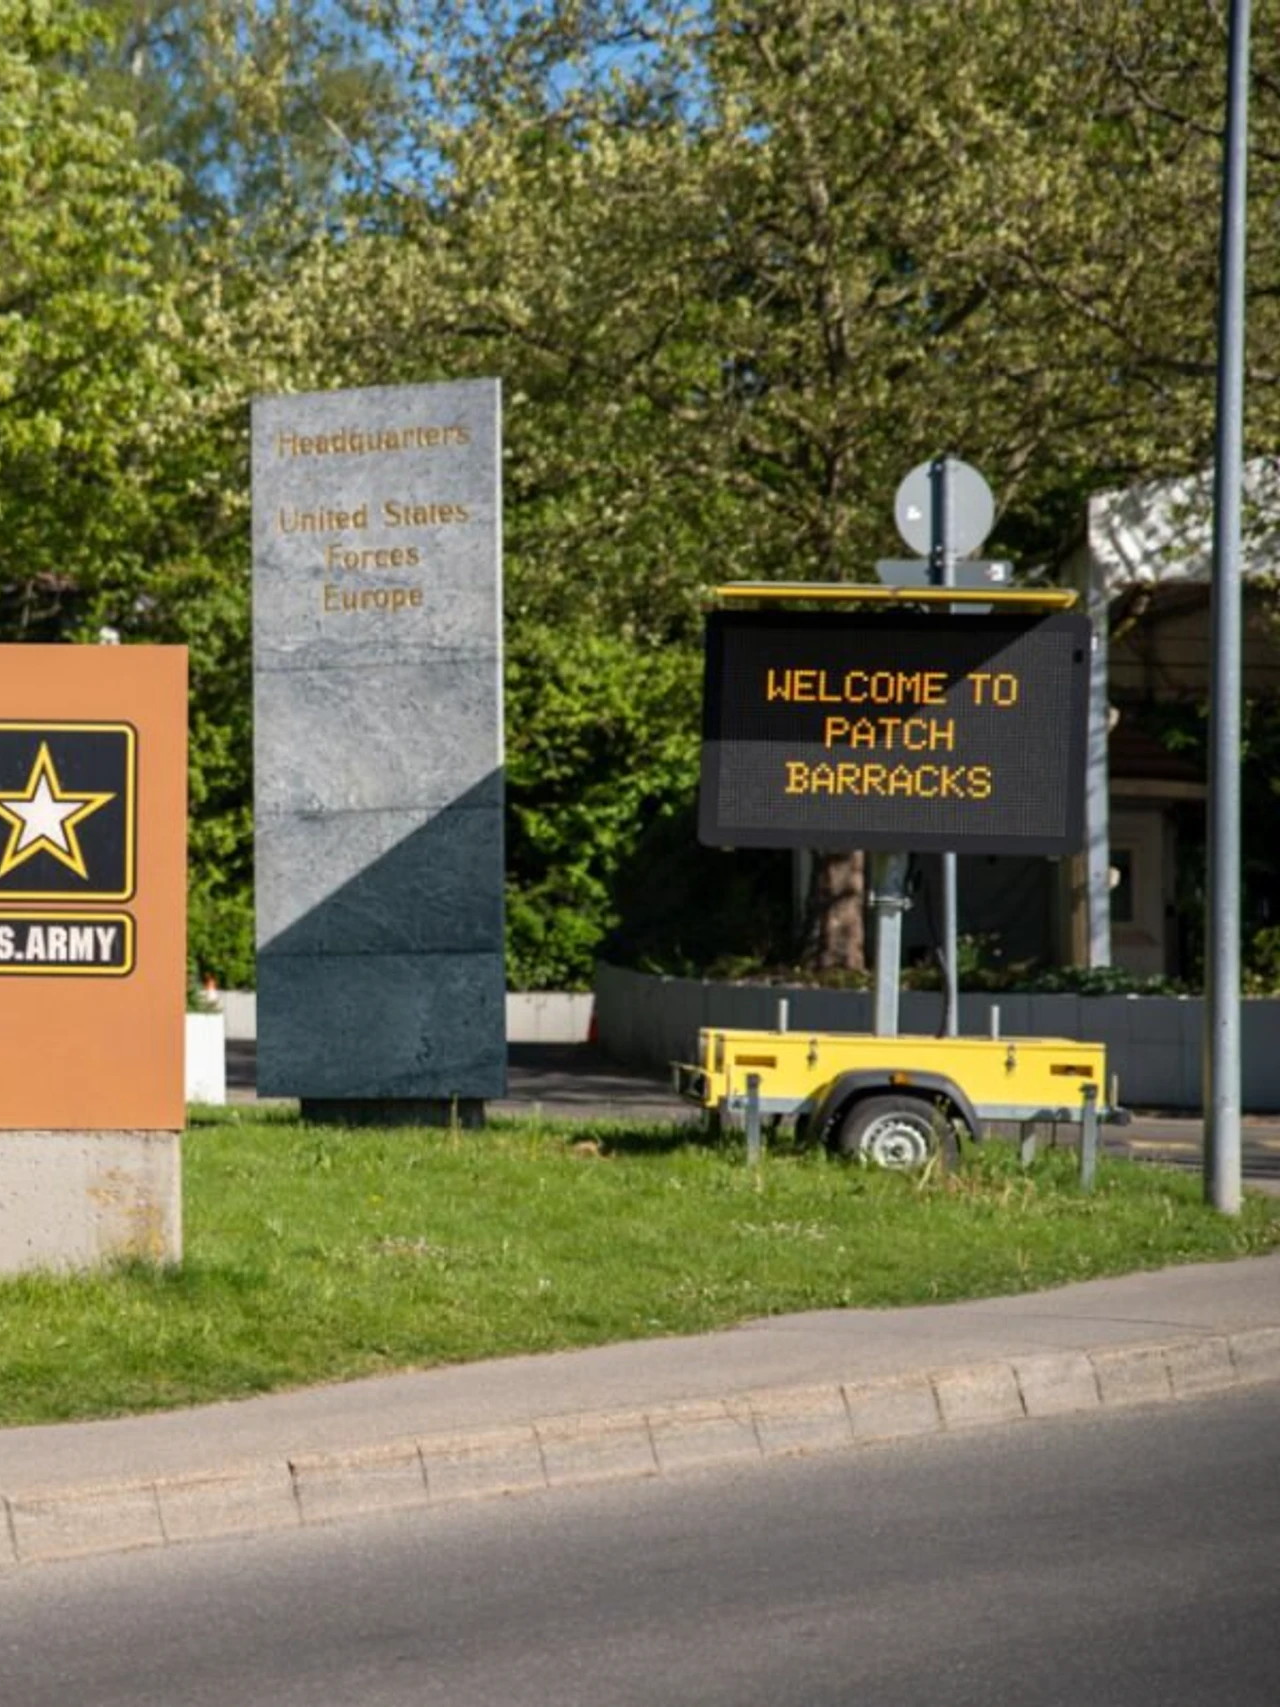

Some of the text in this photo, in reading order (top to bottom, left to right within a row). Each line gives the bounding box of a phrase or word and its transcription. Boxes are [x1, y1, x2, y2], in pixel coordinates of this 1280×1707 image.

[276, 424, 471, 458] Headquarters
[277, 500, 470, 534] United States
[324, 543, 421, 573] Forces
[323, 583, 424, 614] Europe
[766, 669, 1019, 706] WELCOME TO
[824, 716, 956, 752] PATCH
[784, 761, 993, 799] BARRACKS
